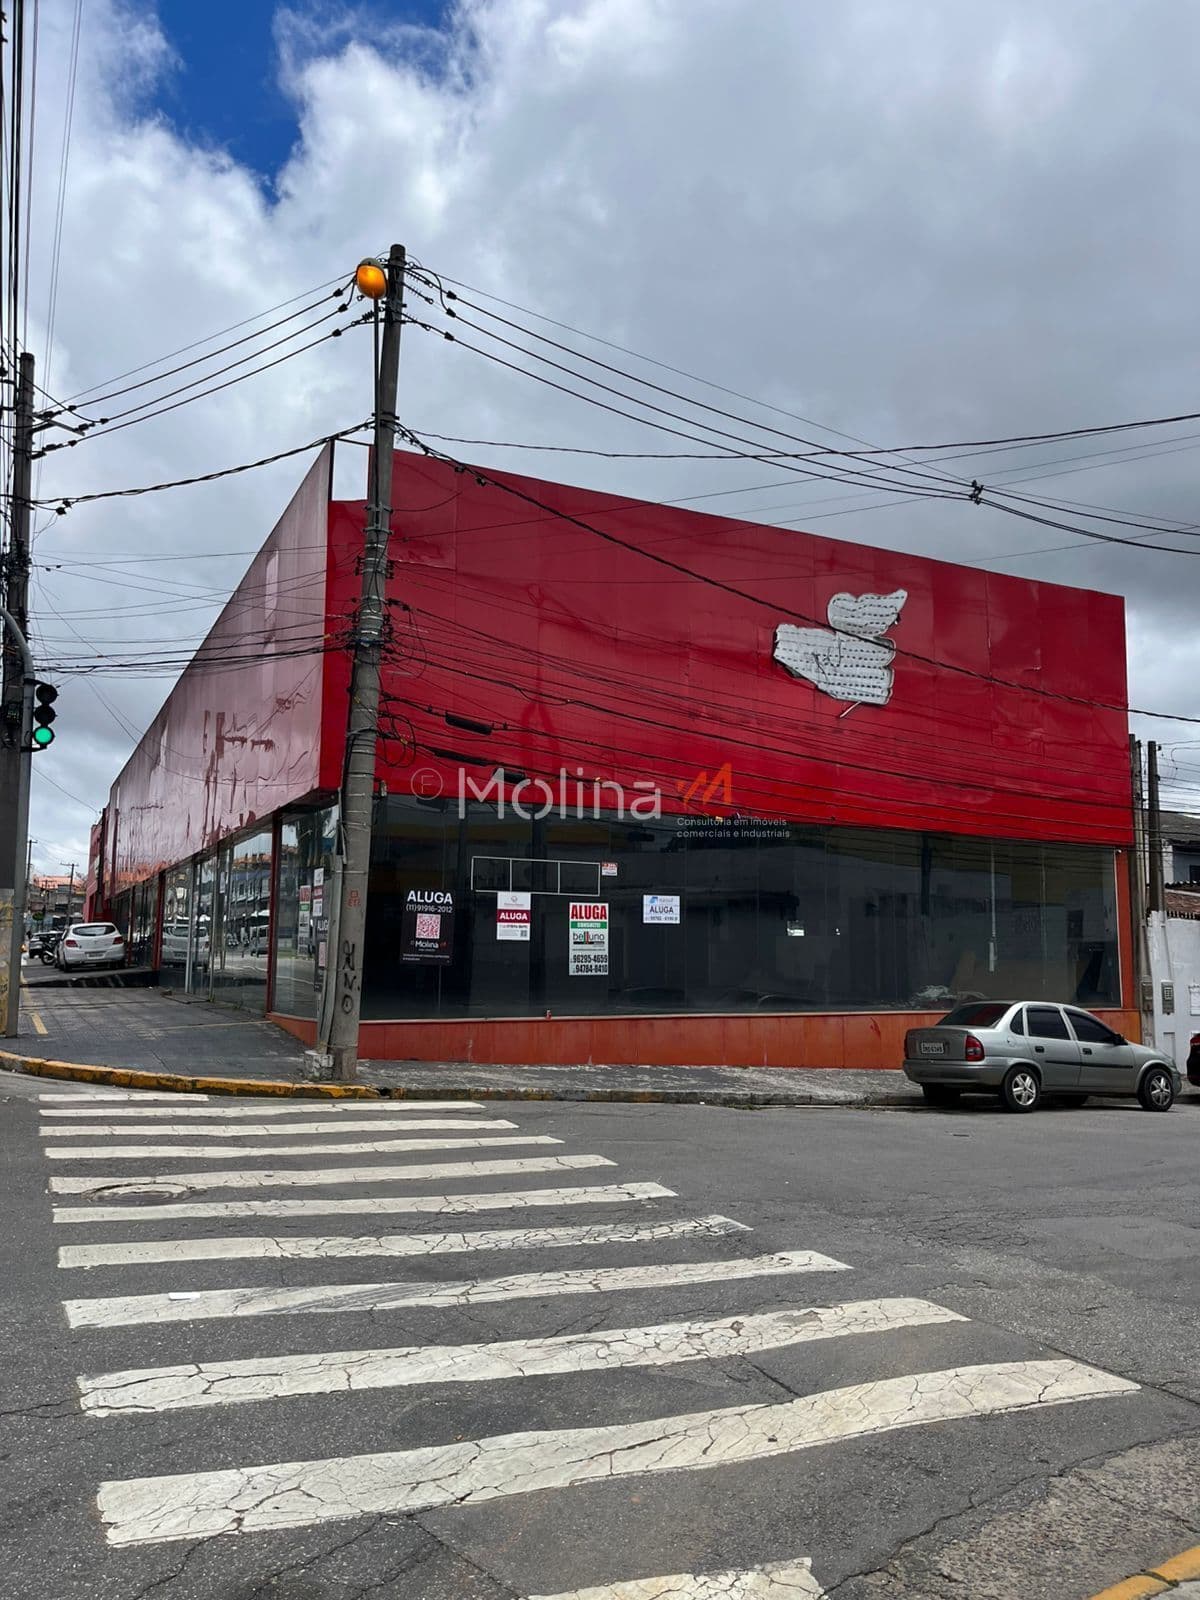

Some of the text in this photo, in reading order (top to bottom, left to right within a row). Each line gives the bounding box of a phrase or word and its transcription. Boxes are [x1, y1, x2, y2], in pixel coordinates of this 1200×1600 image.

[407, 890, 453, 905] ALUGA
[570, 904, 607, 920] ALUGA
[649, 905, 674, 914] ALUGA
[499, 912, 528, 921] ALUGA
